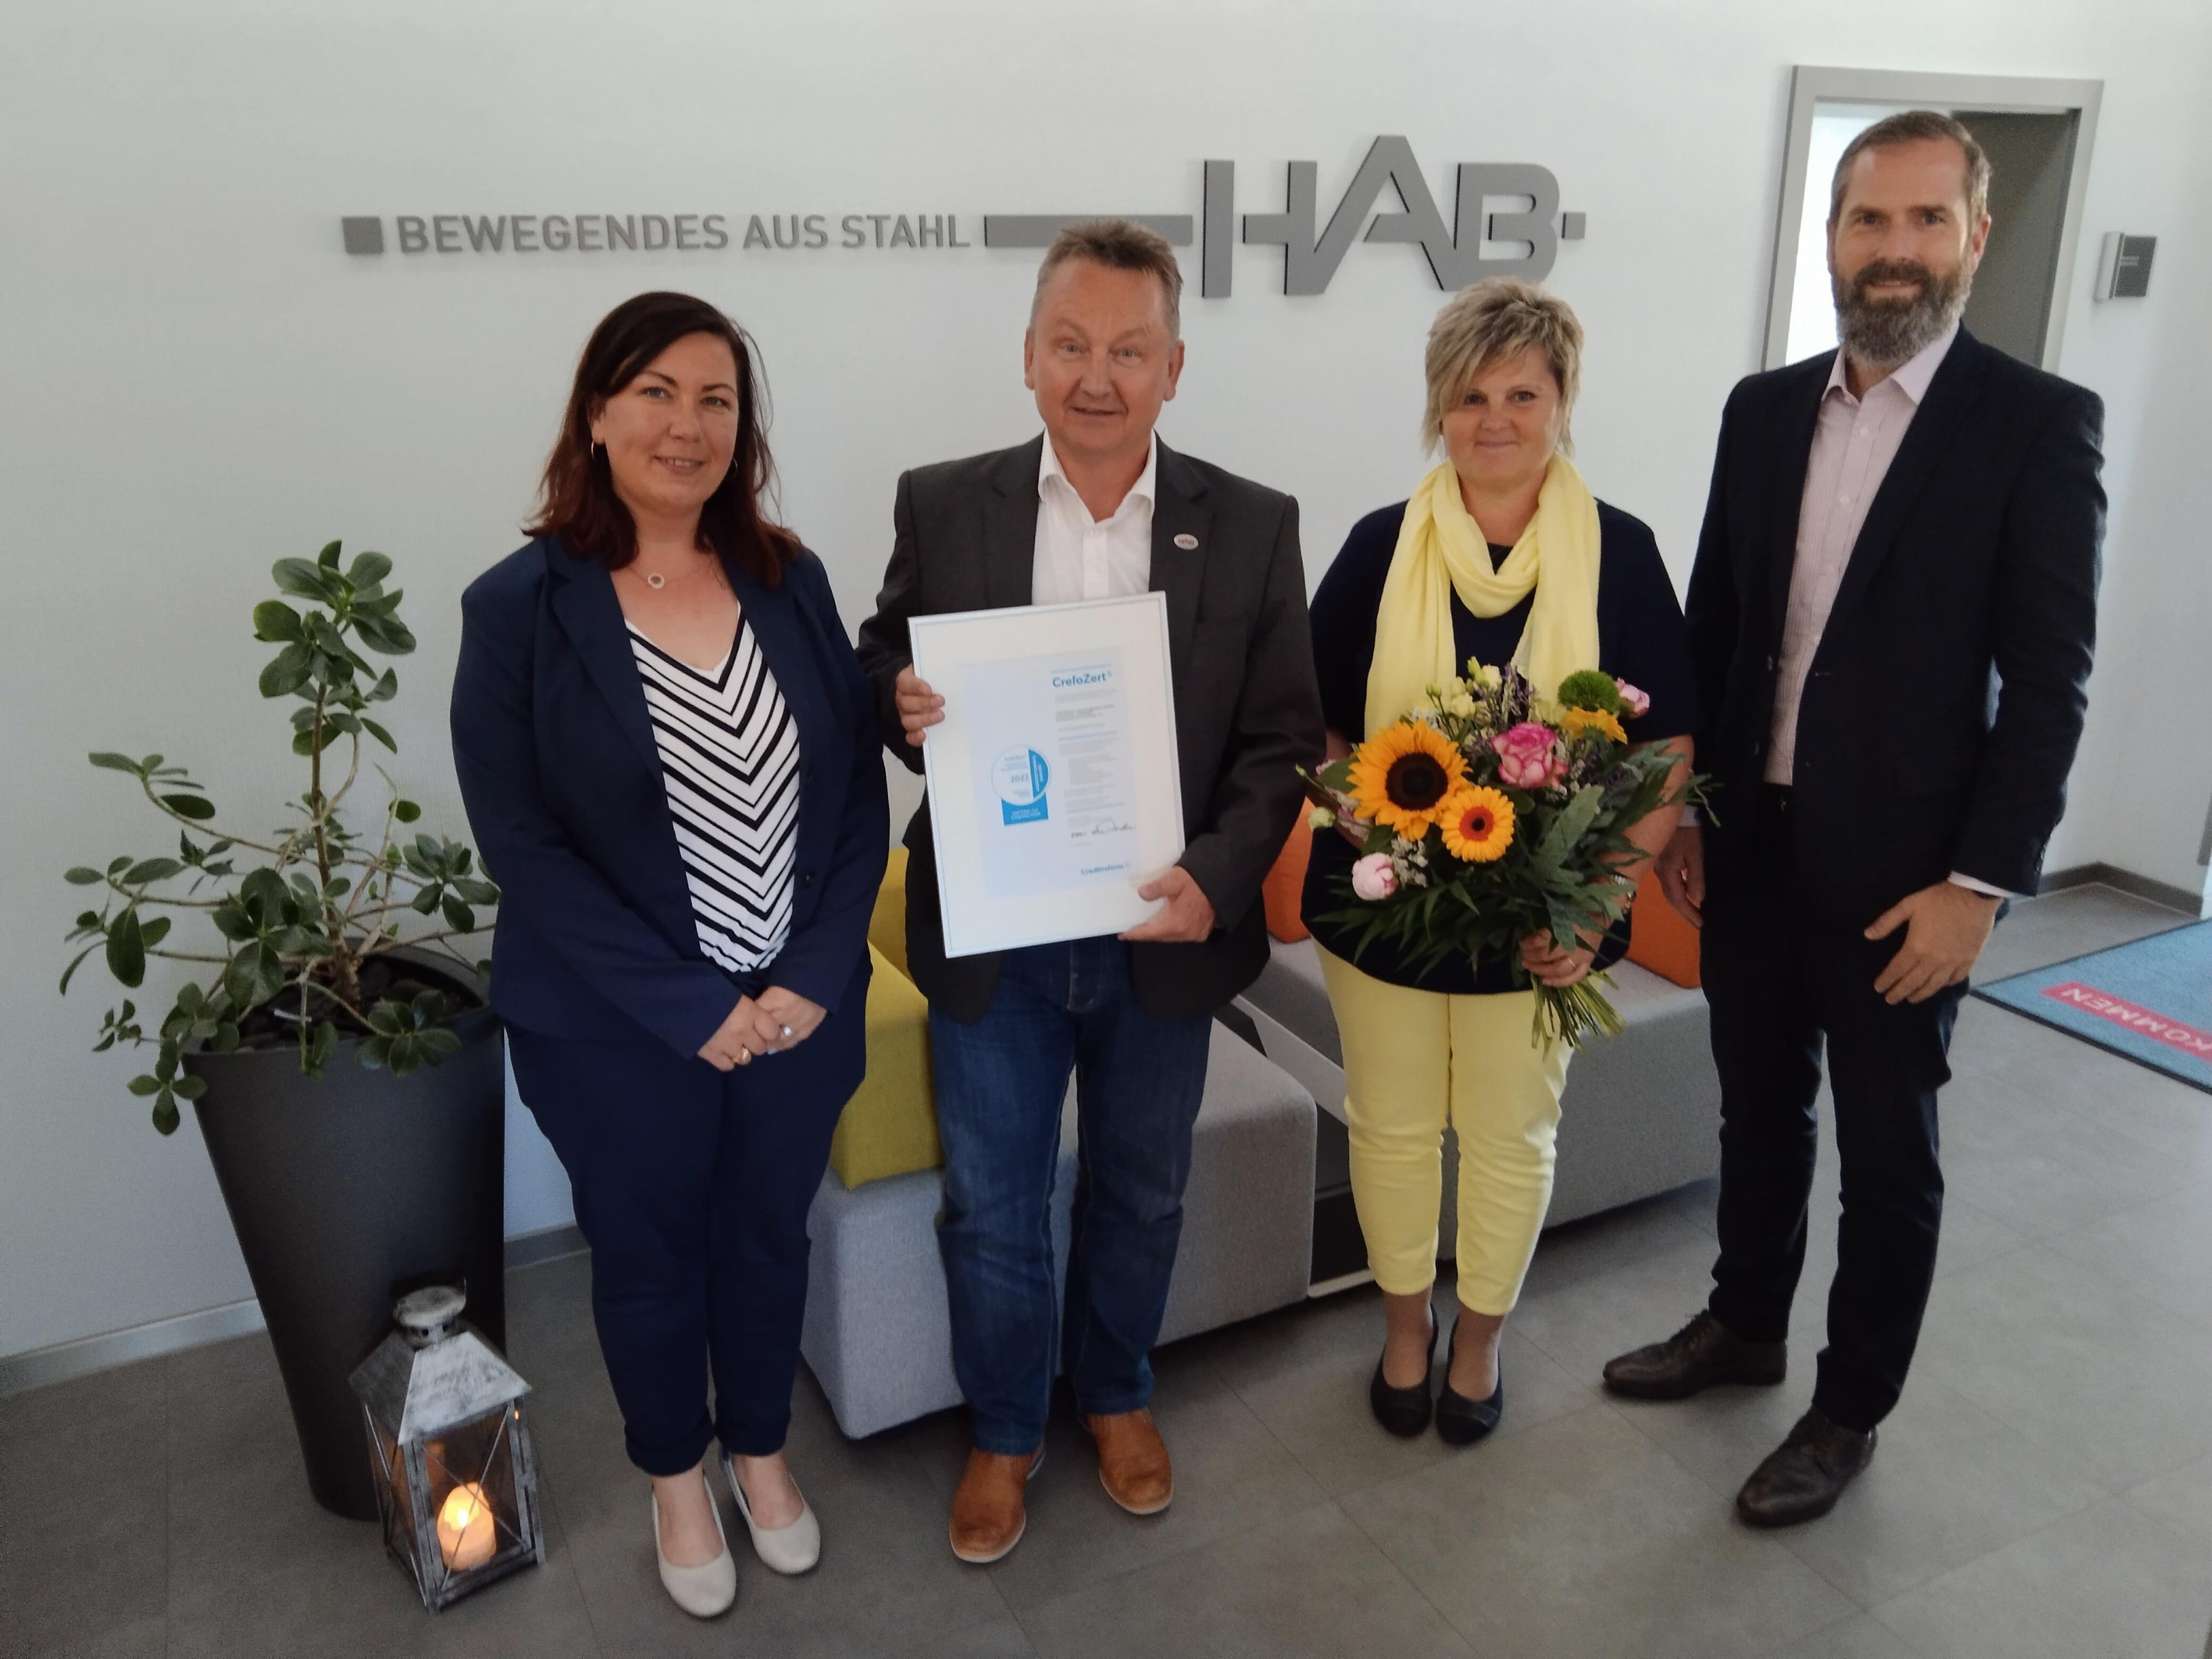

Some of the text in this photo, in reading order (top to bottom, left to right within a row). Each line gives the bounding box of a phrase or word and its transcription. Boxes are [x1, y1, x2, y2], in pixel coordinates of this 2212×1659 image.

[397, 214, 971, 252] BEWEGENDES AUS STAHL
[1202, 135, 1560, 297] HAB
[1052, 672, 1106, 688] CrefoZert
